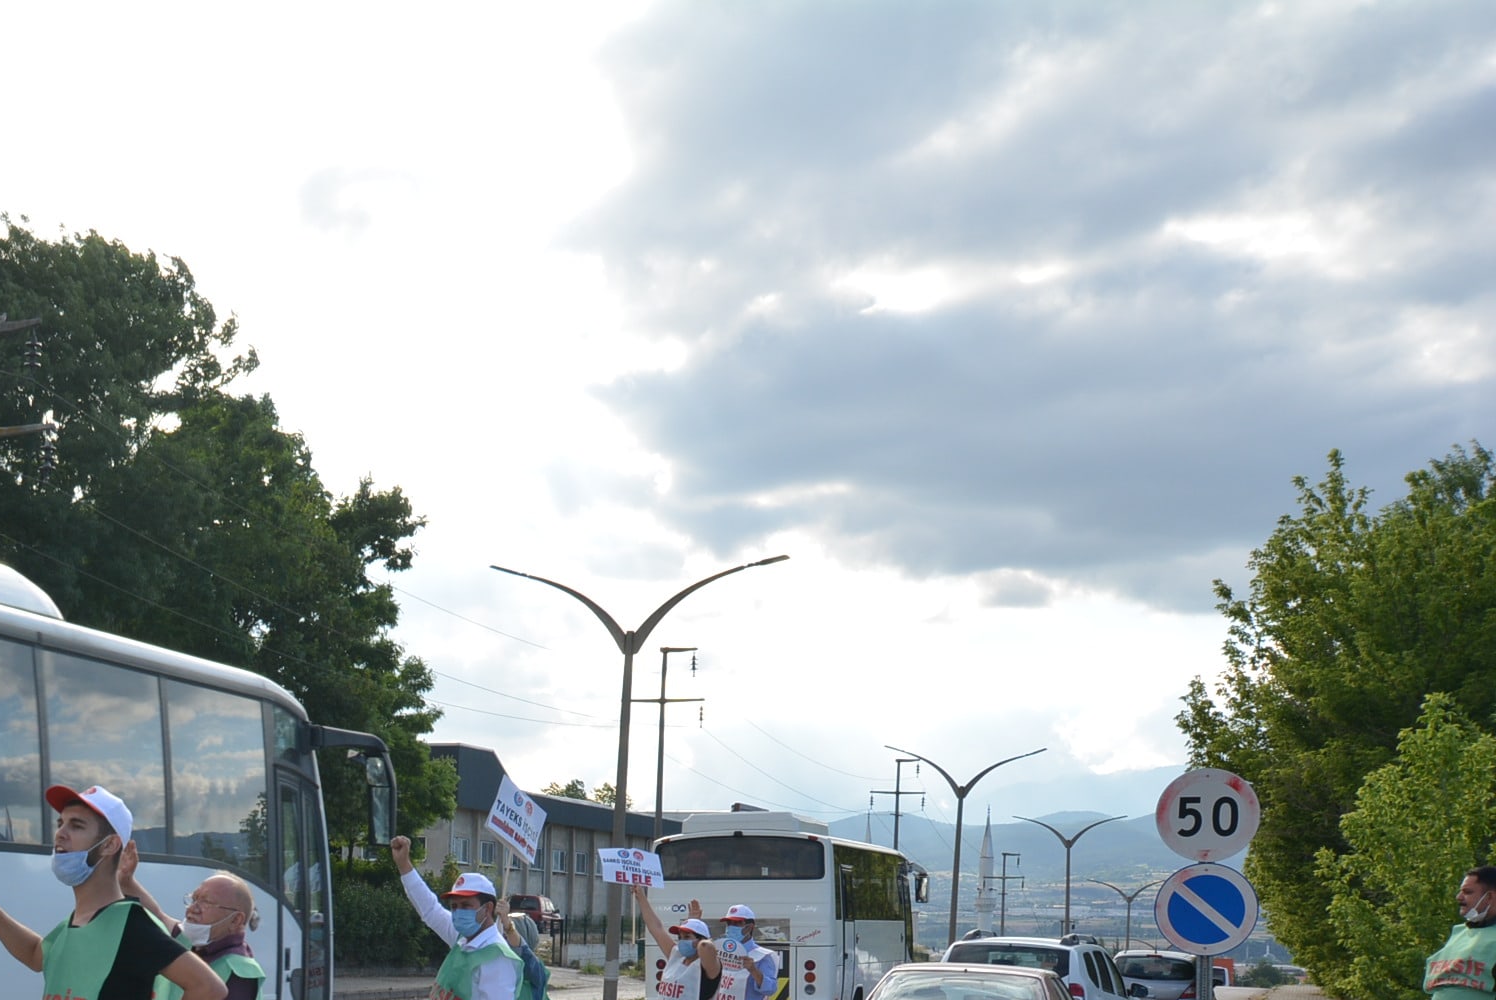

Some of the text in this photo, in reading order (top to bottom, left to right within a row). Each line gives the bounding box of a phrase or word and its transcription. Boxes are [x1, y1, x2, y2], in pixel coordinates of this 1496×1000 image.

[495, 800, 522, 827] TAYEKS
[1177, 796, 1239, 837] 50
[615, 871, 652, 886] EL ELE
[658, 981, 685, 999] EKSİF
